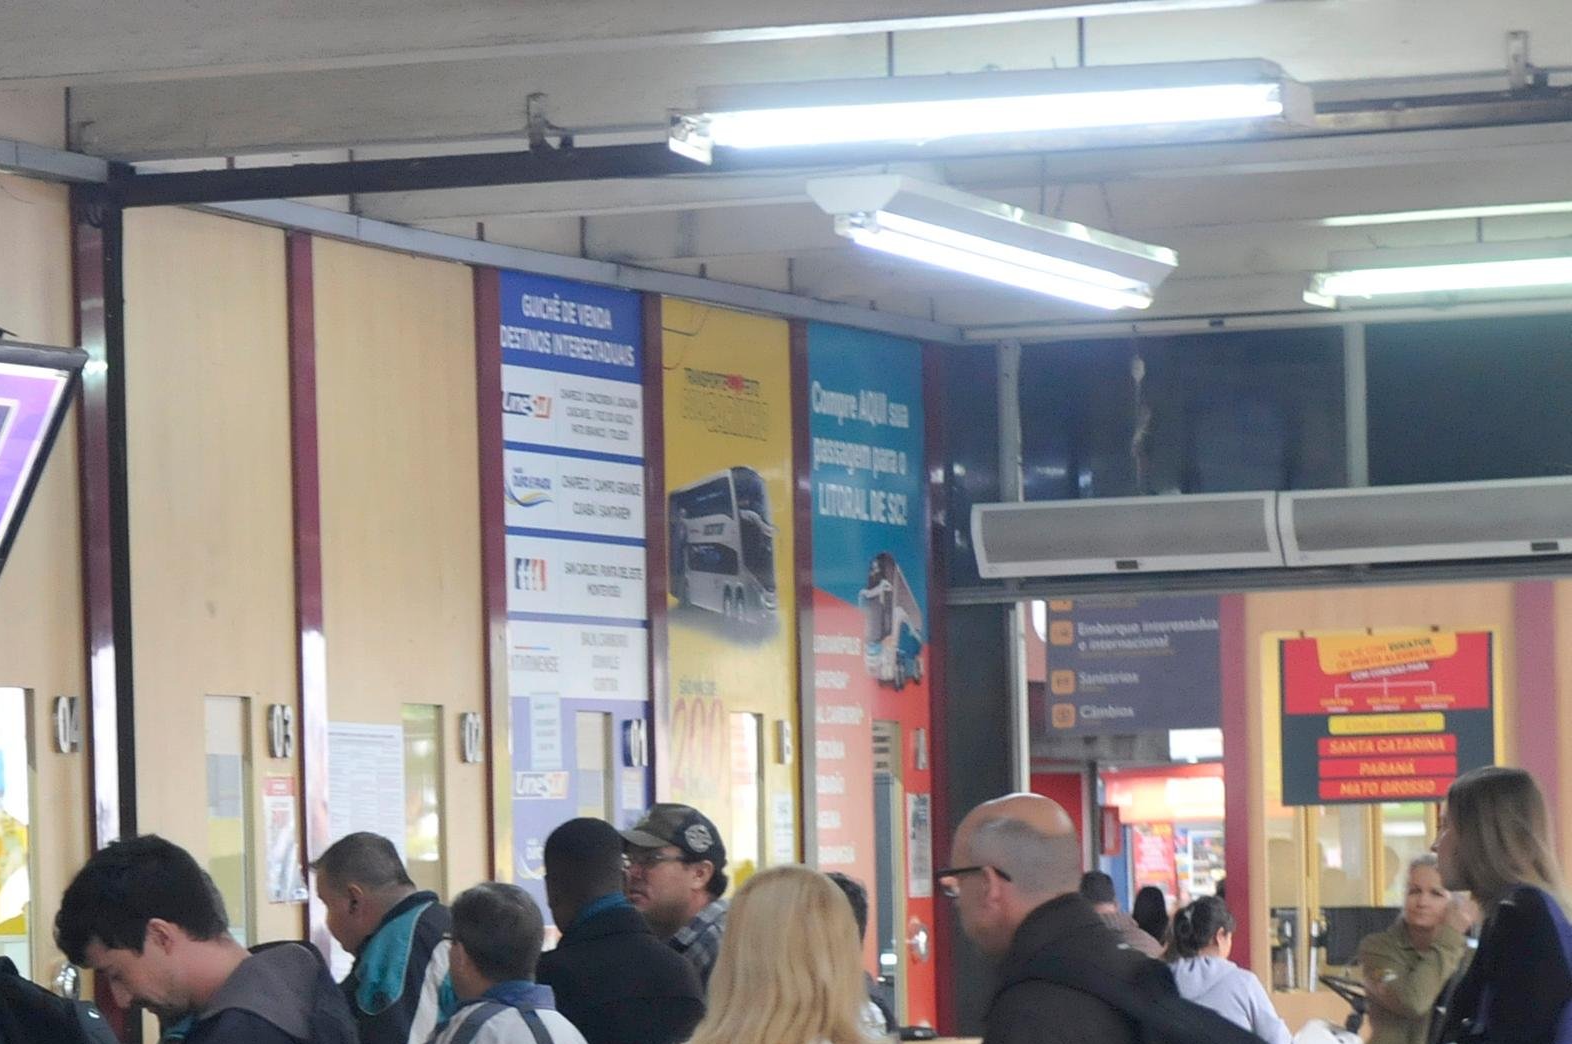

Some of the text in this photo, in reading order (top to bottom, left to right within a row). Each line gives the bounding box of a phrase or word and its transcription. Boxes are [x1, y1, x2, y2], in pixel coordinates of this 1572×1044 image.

[579, 304, 613, 330] VENDA
[499, 324, 551, 354] DESTINOS
[812, 380, 858, 426] Compre
[859, 388, 888, 427] AQUI
[889, 402, 909, 428] sua
[812, 437, 871, 476] passagem
[872, 445, 897, 480] para
[818, 482, 870, 521] LITORAL
[870, 489, 887, 523] DE
[1078, 620, 1141, 636] Embarque
[1089, 634, 1170, 650] internacional
[56, 696, 83, 753] 04
[271, 703, 292, 758] 03
[628, 718, 648, 768] 01
[1329, 735, 1445, 755] SANTA CATARINA
[1359, 757, 1416, 776] PARANÁ
[1340, 778, 1437, 796] MATO GROSSO
